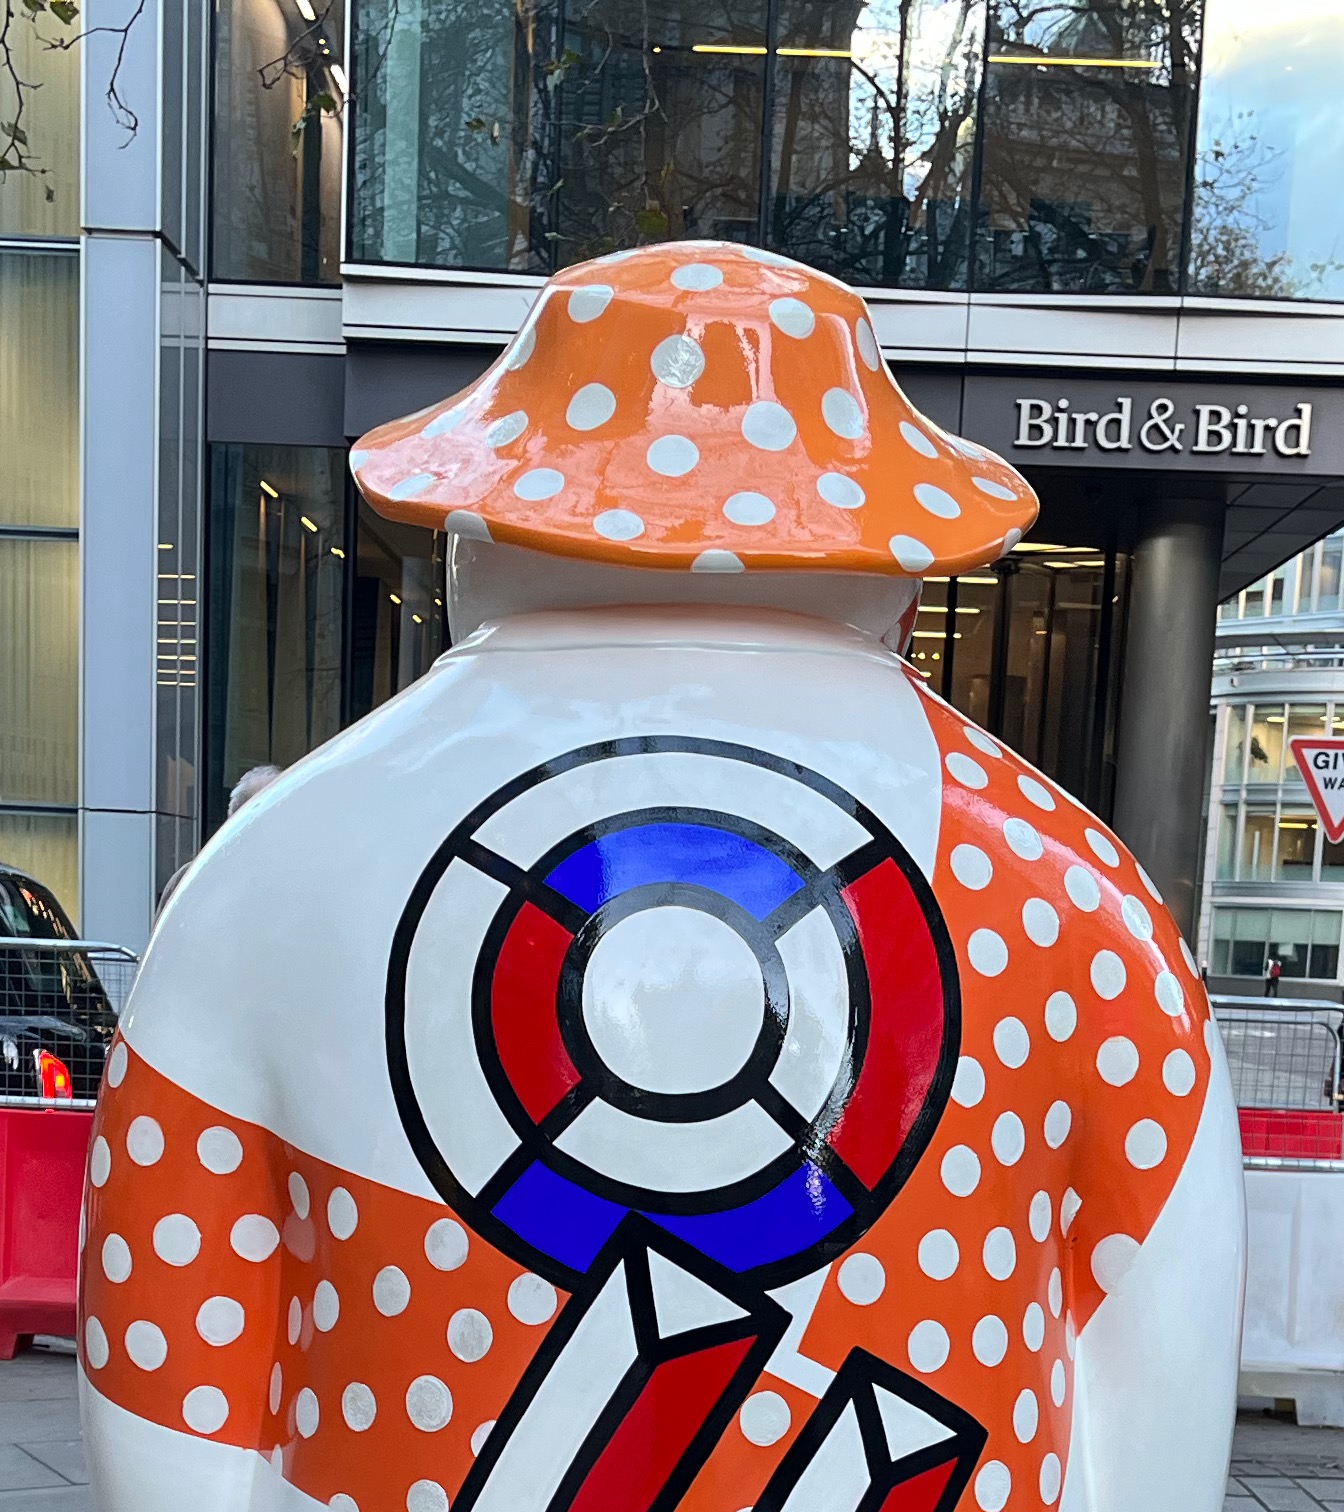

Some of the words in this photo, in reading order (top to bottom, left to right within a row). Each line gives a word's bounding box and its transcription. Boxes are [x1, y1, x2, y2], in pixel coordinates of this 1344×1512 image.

[1014, 397, 1133, 449] Bird
[1139, 397, 1185, 451] &
[1192, 402, 1313, 455] Bird
